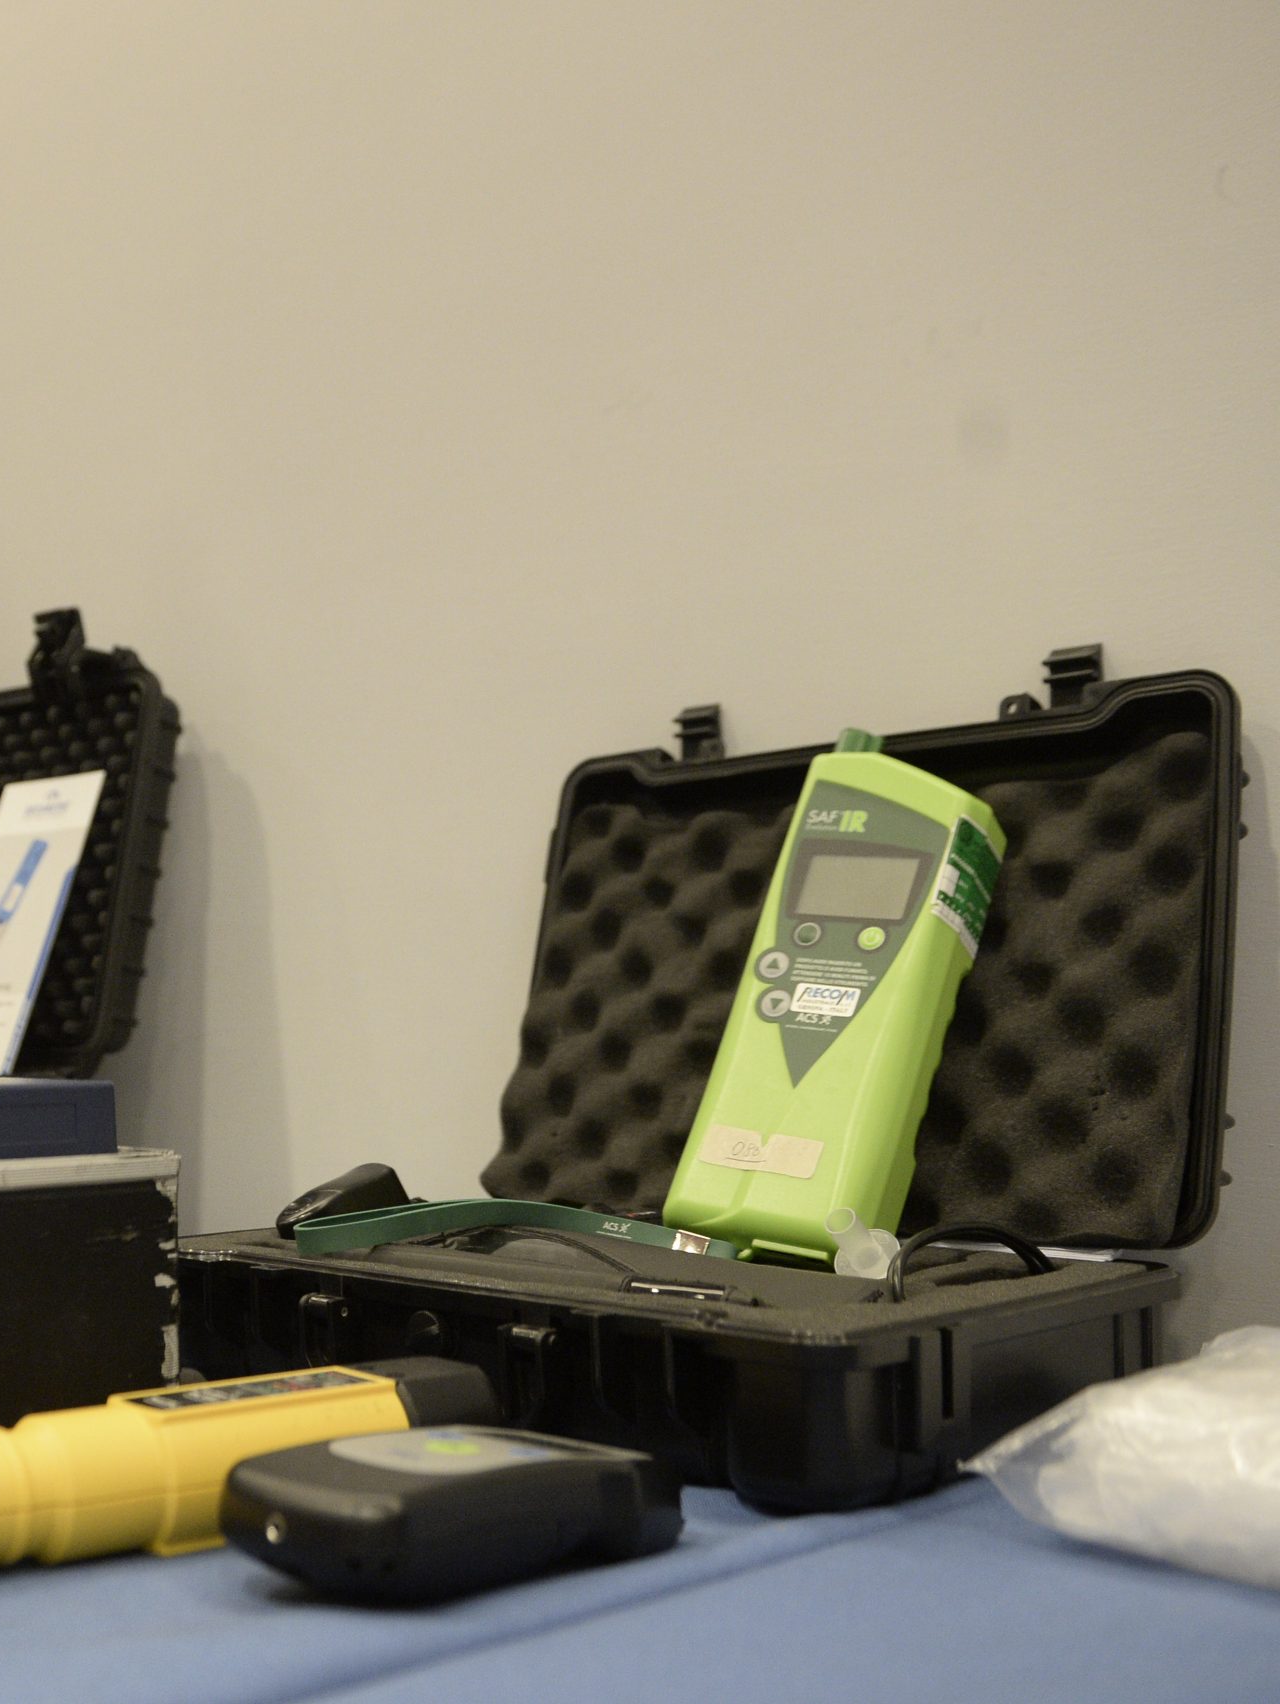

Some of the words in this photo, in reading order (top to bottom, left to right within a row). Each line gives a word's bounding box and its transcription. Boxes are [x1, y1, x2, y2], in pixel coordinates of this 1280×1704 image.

[806, 809, 839, 824] SAF
[795, 1012, 819, 1024] ACS
[602, 1220, 619, 1232] ACS
